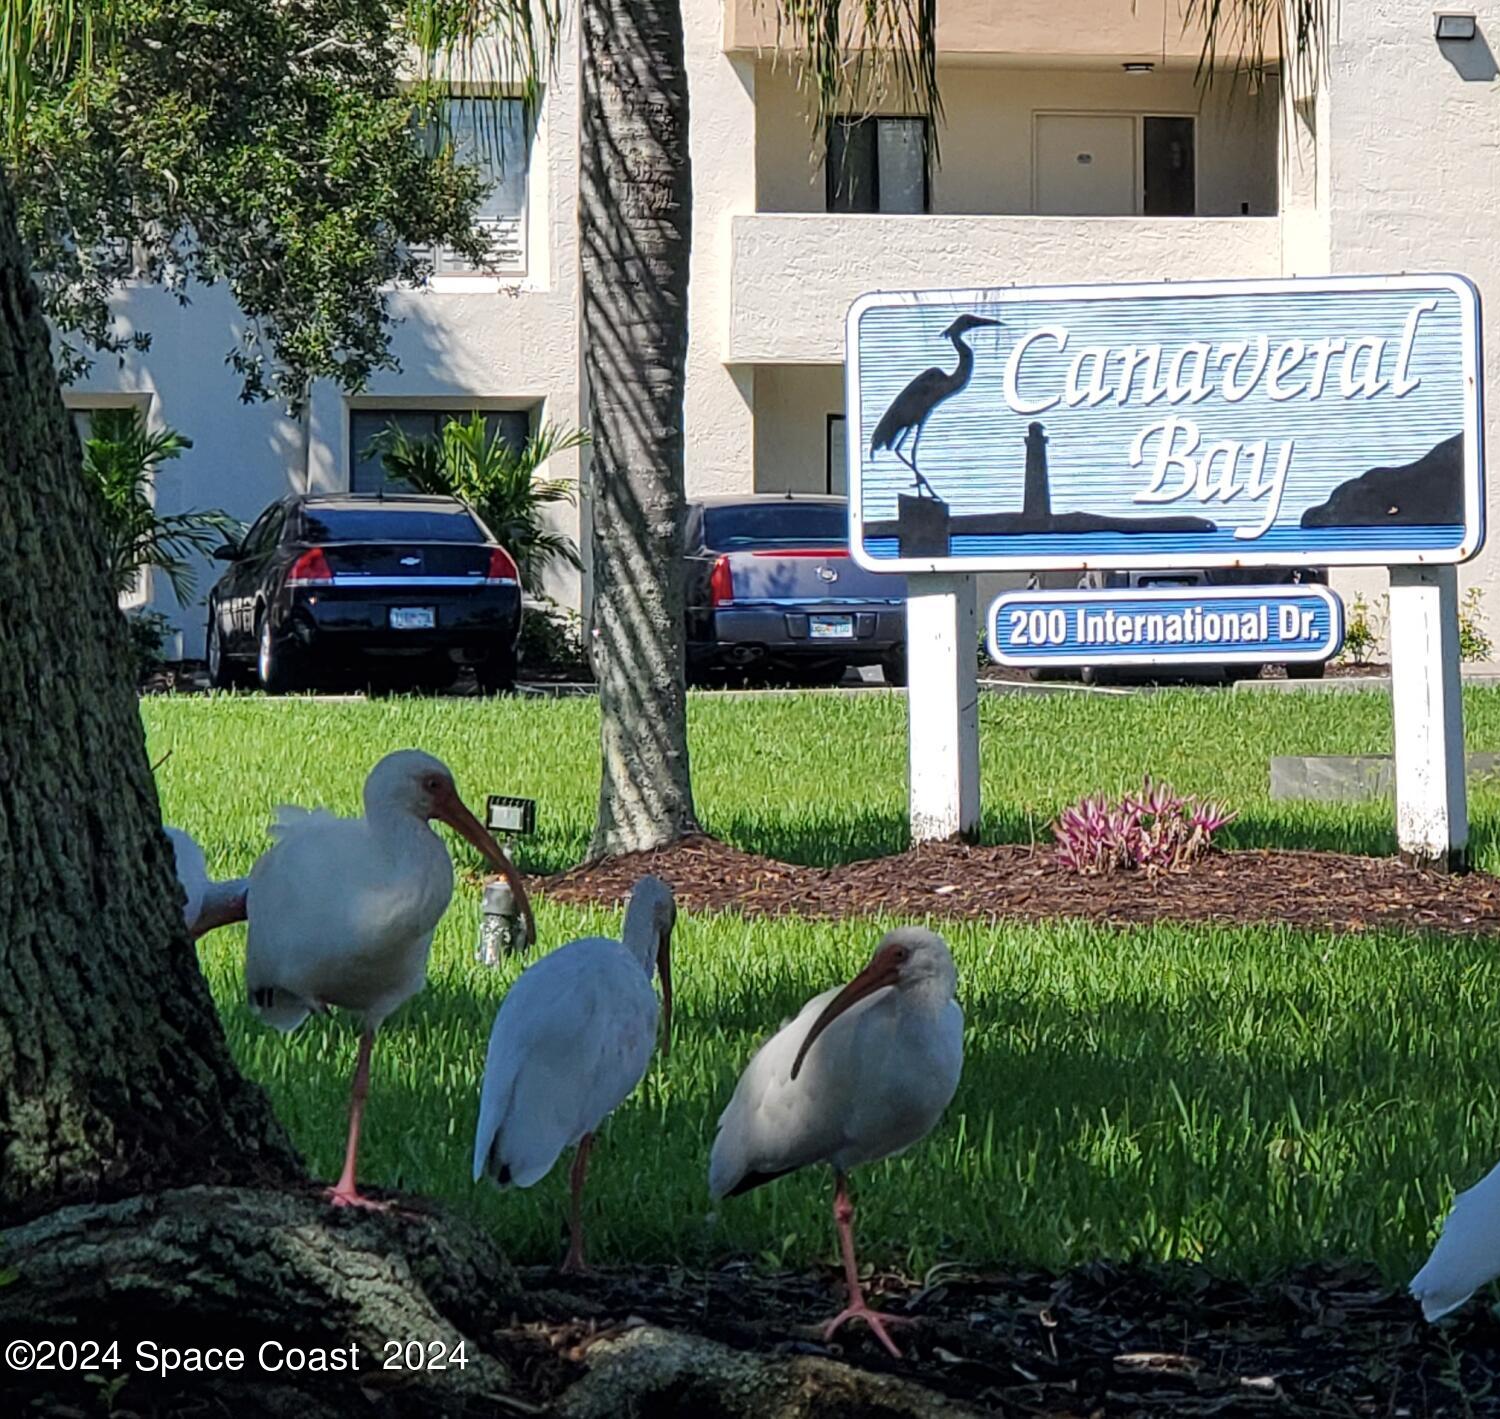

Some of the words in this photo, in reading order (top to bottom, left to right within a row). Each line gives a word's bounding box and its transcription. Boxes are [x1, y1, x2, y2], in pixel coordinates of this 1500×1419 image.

[1004, 299, 1439, 414] Canaveral
[1129, 416, 1295, 540] Bay
[1009, 608, 1067, 645] 200
[1077, 605, 1269, 643] International
[1279, 604, 1320, 640] Dr.
